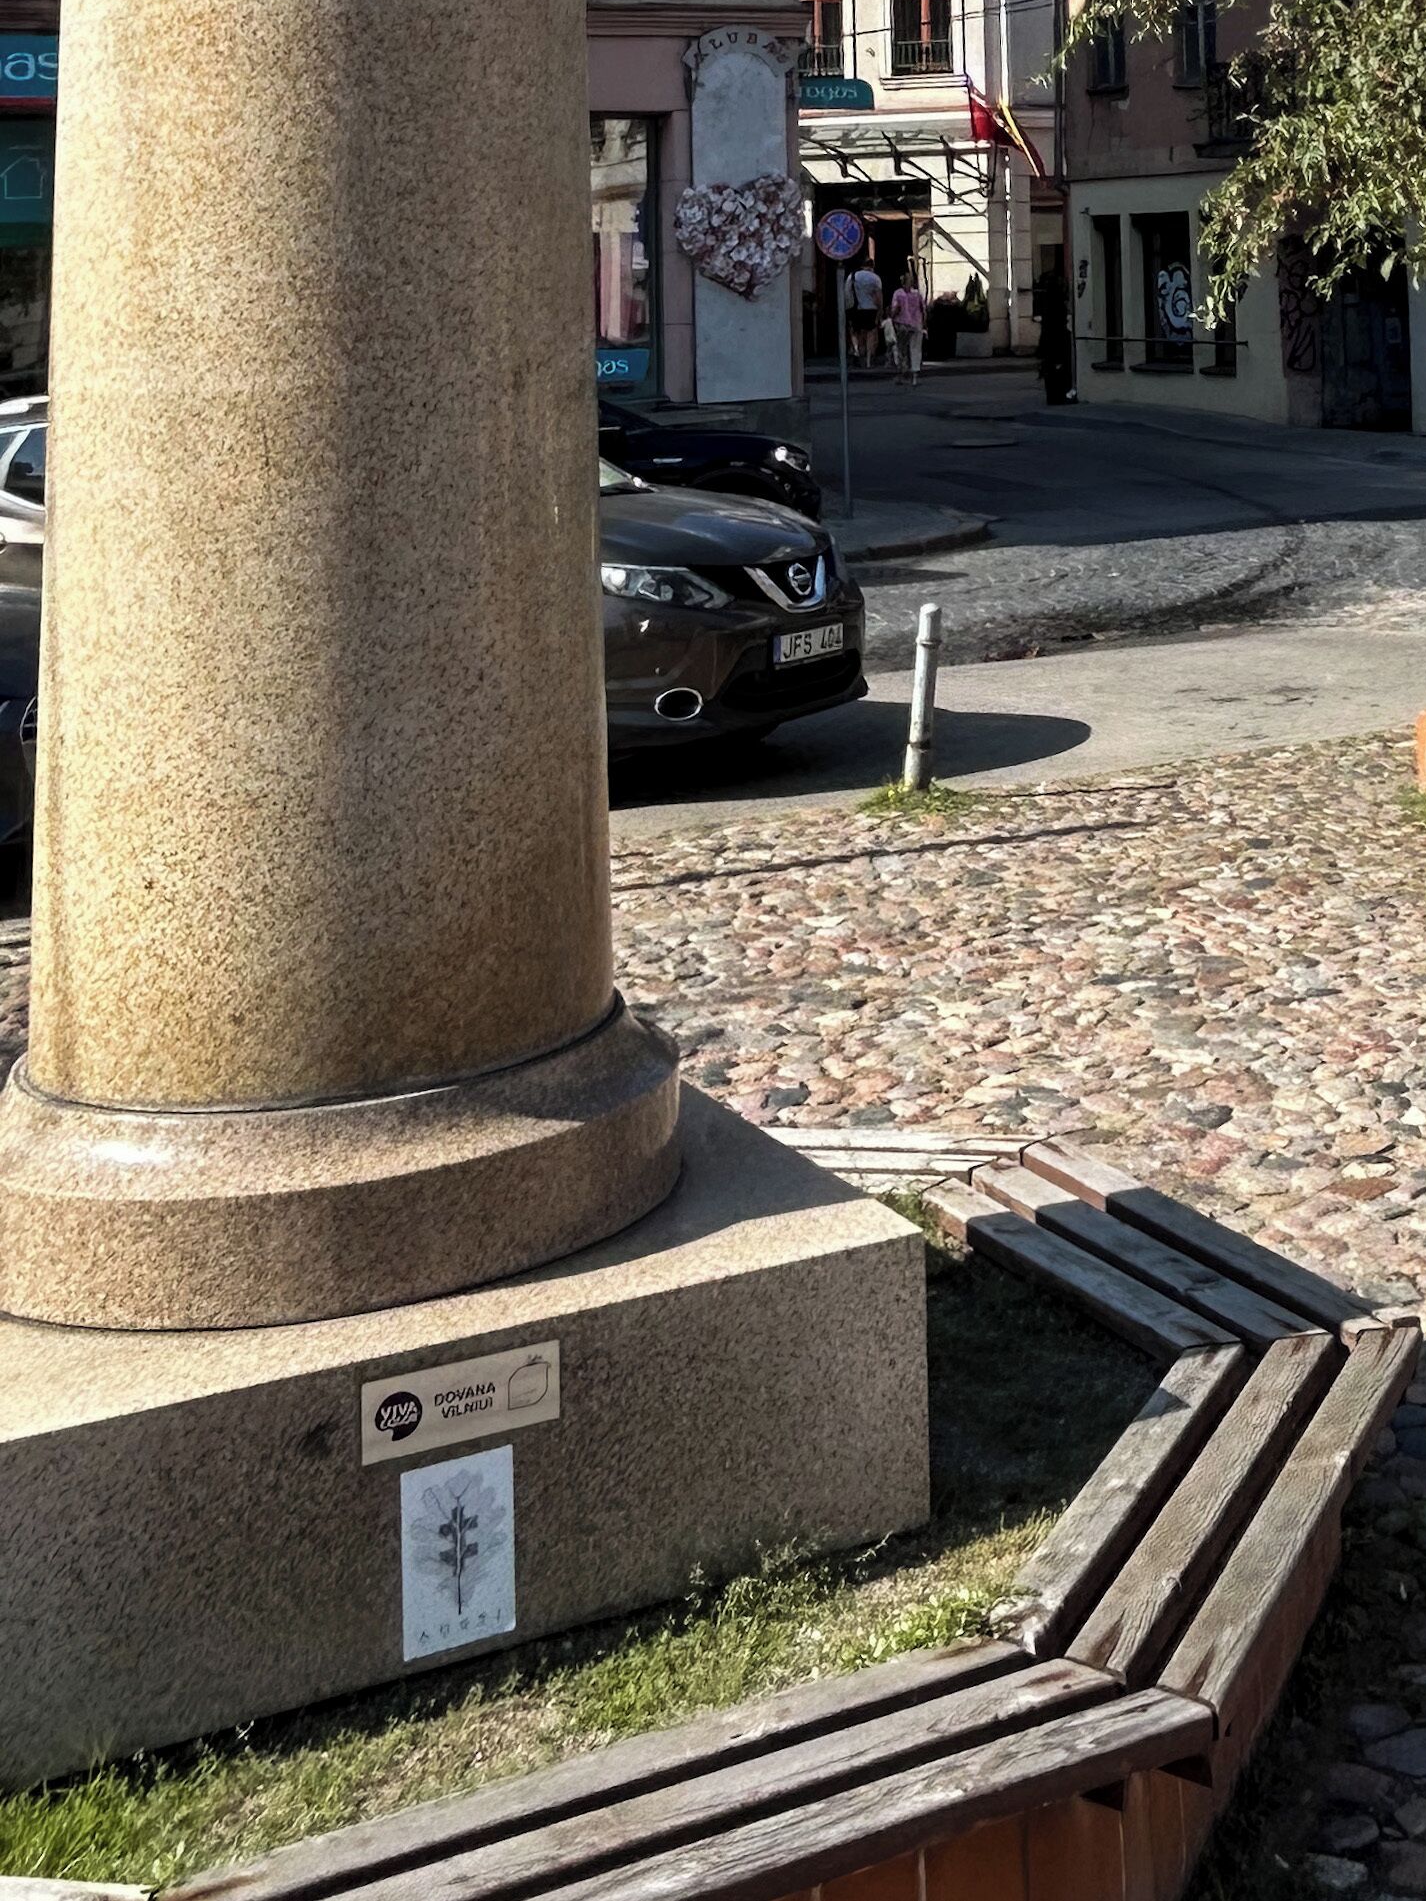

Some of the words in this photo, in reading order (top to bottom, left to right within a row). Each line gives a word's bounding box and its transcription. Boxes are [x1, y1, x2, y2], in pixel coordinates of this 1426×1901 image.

[0, 52, 58, 81] as
[783, 633, 812, 659] JFS
[434, 1382, 496, 1407] DOVANA
[441, 1396, 493, 1419] VILNIUI
